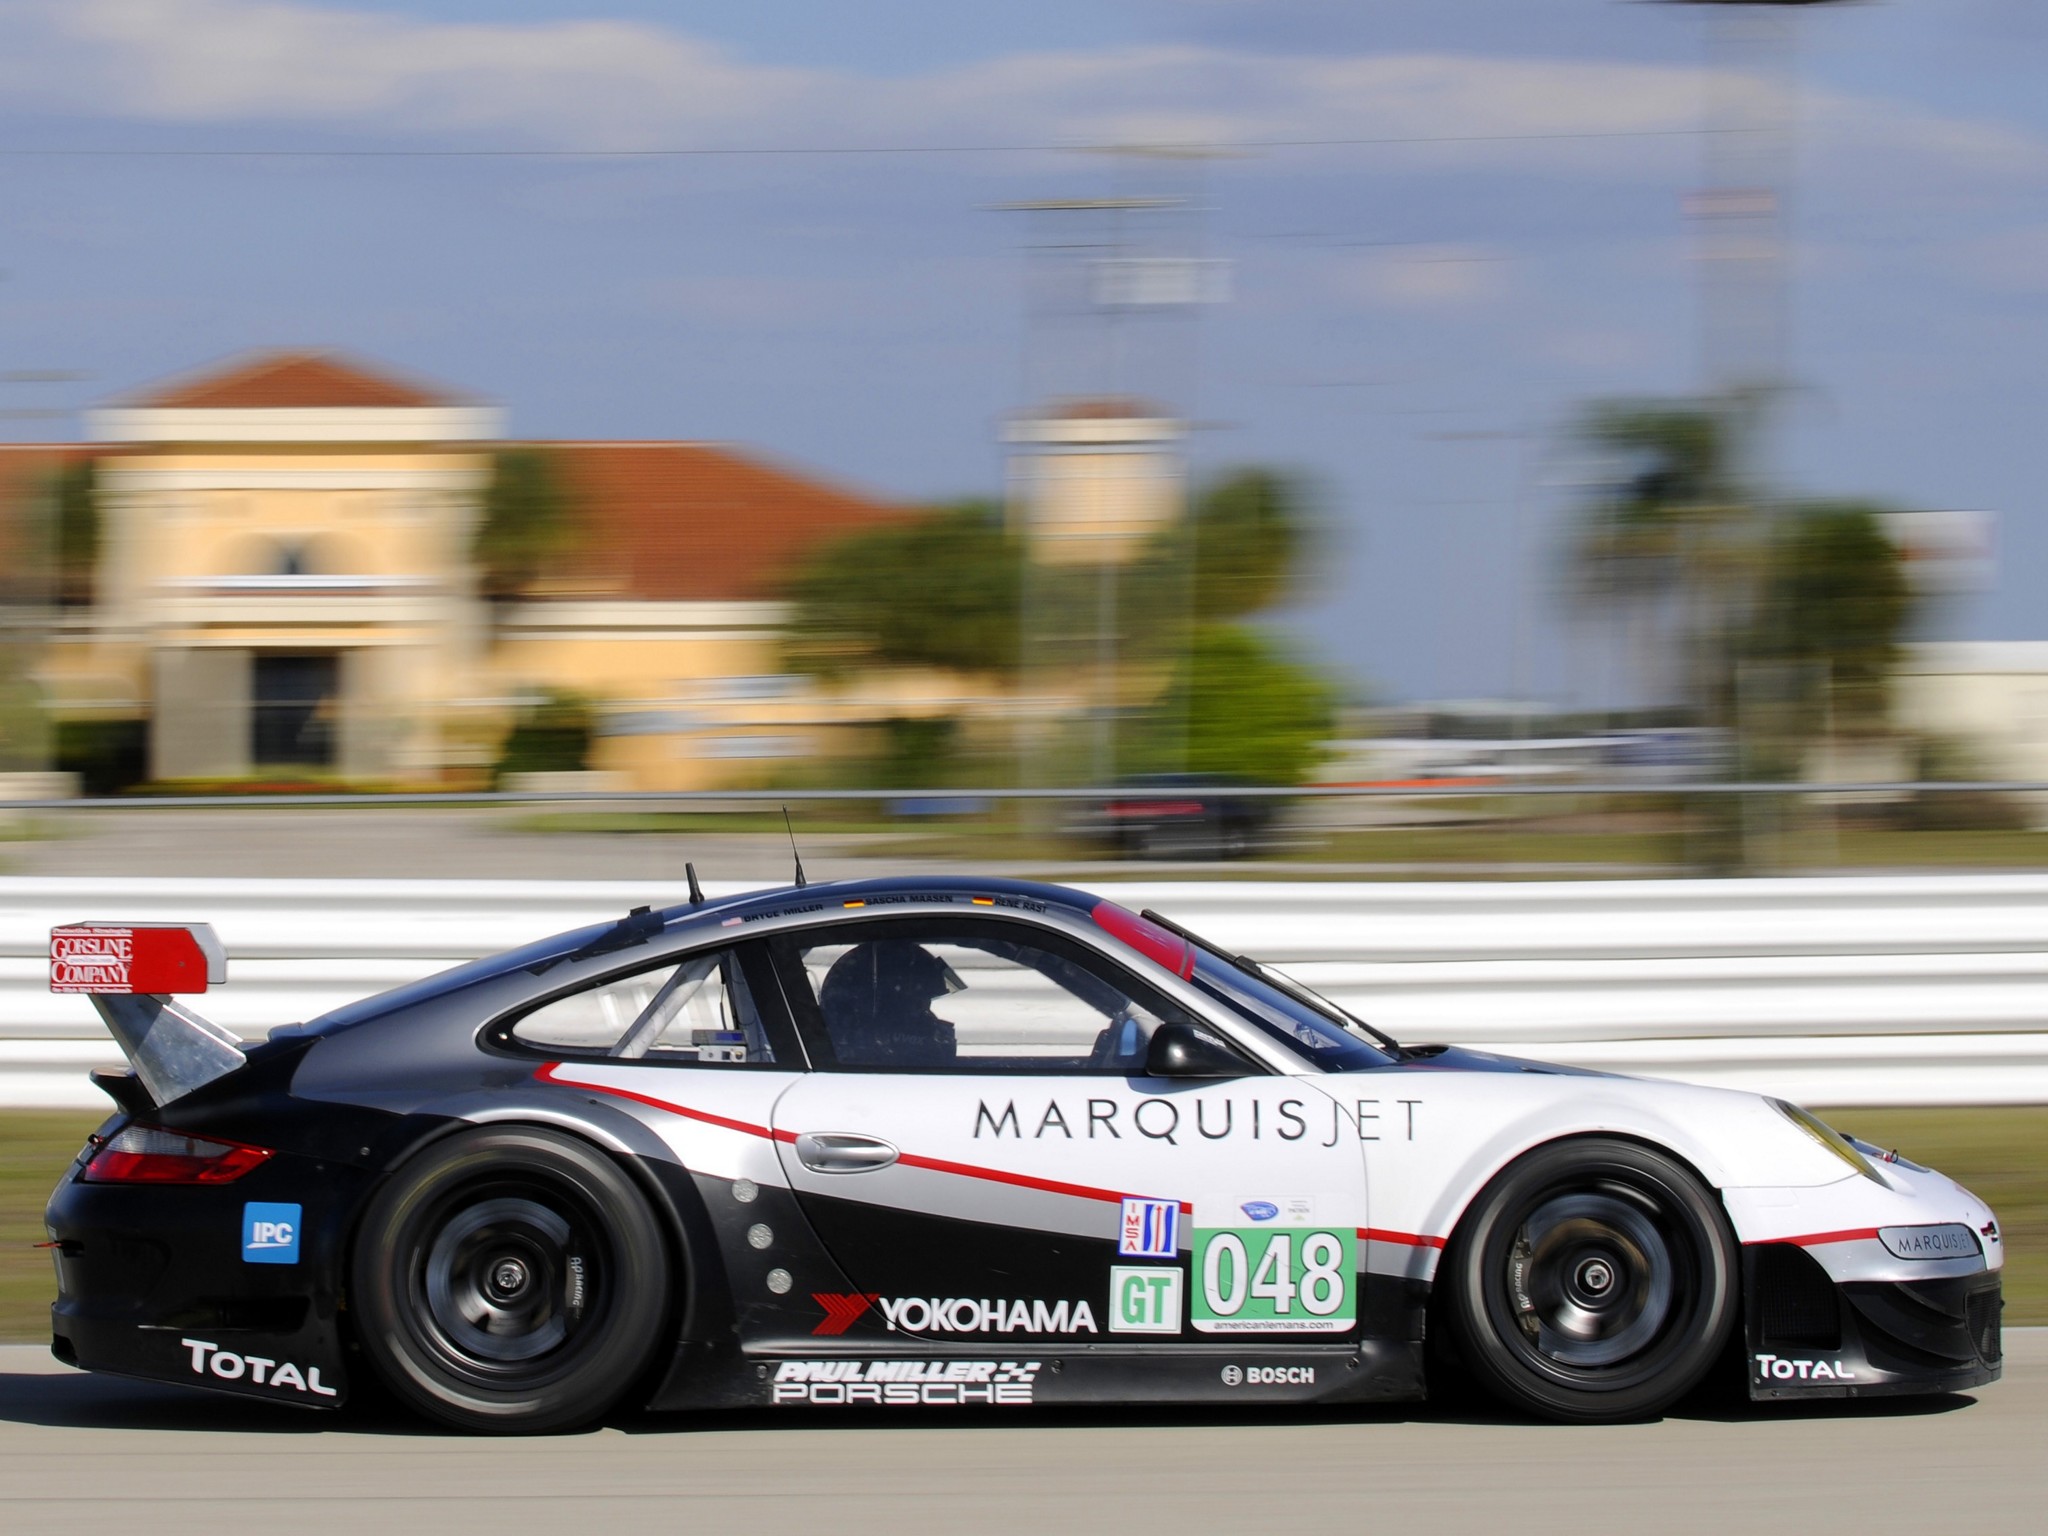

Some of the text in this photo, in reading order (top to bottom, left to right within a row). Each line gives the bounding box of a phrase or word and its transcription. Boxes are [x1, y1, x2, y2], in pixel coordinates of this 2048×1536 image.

[783, 903, 824, 916] MILLER
[866, 895, 954, 905] SASCHA MAASEN
[1022, 901, 1048, 914] RAST
[50, 938, 134, 960] GORSLINE
[51, 961, 131, 983] COMPANY
[252, 1221, 294, 1244] IPC
[1124, 1202, 1141, 1252] IMSA
[1202, 1231, 1346, 1317] 048
[1121, 1275, 1172, 1325] GT
[879, 1297, 1098, 1334] YOKOHAMA
[1214, 1320, 1334, 1331] americanlemans.com
[181, 1337, 337, 1397] TOTAL
[773, 1361, 998, 1383] PAUL MILLER
[1246, 1366, 1315, 1384] BOSCH
[1755, 1354, 1856, 1379] TOTAL
[772, 1383, 1033, 1405] PORSCHE
